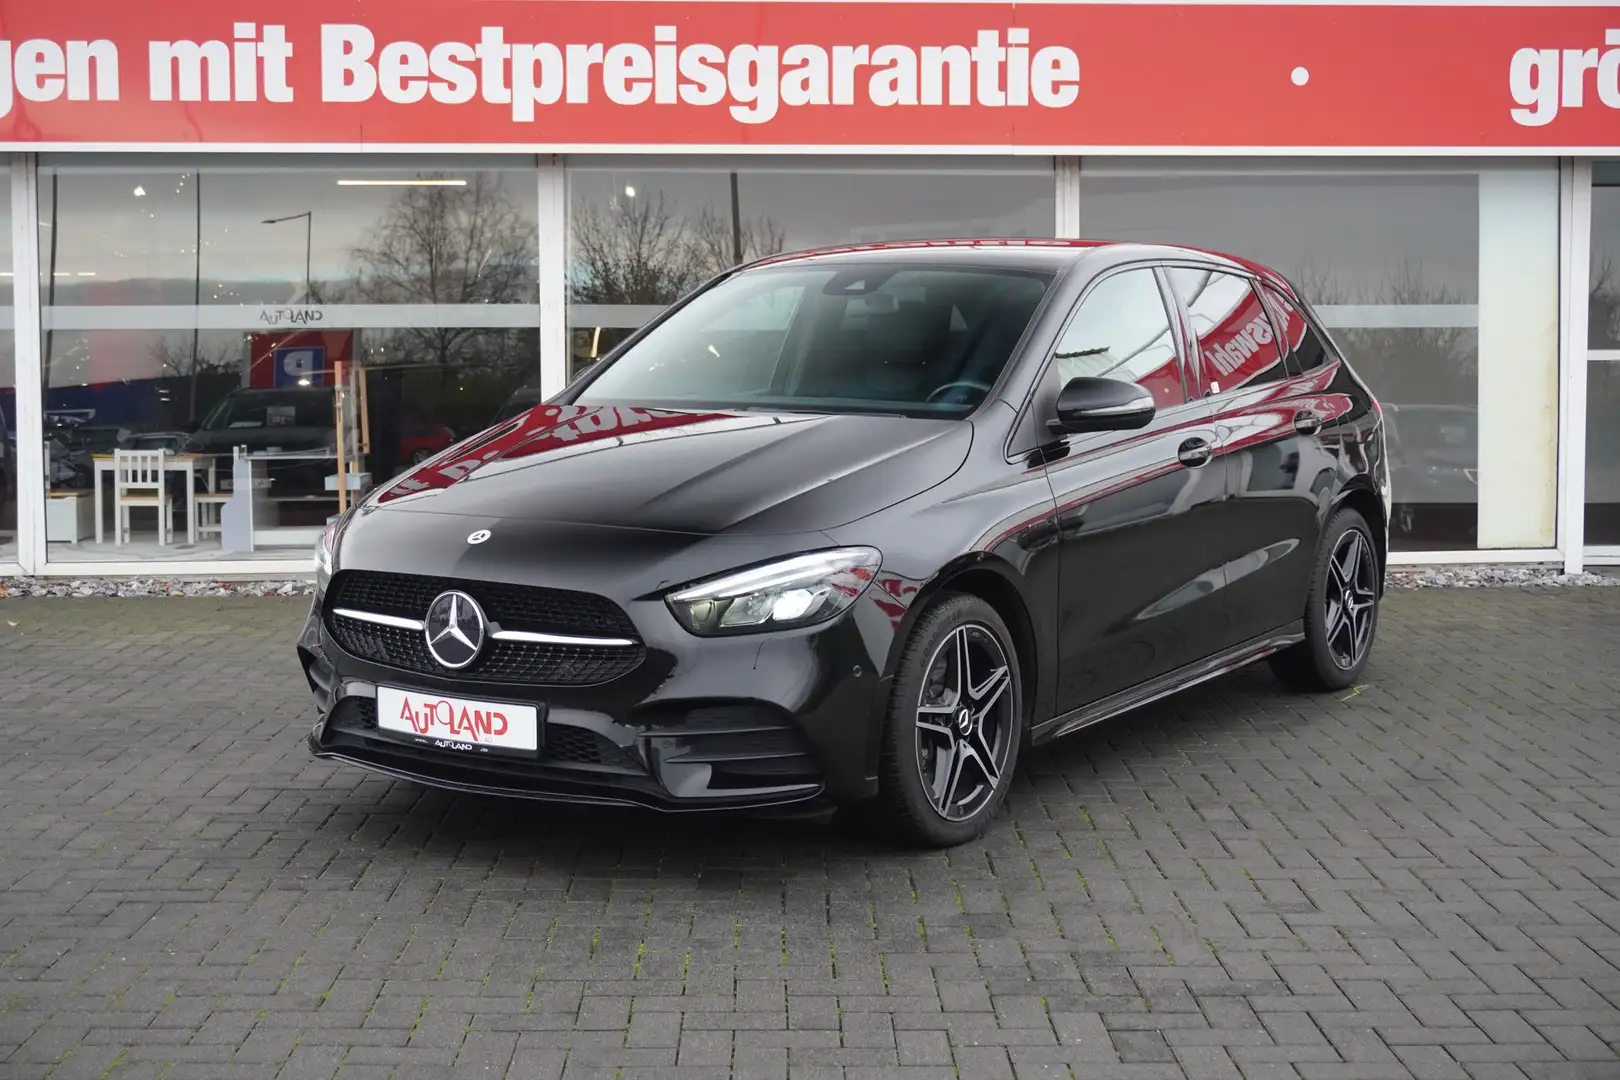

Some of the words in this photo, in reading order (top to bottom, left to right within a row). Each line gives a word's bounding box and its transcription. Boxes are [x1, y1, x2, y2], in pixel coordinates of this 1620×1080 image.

[0, 39, 119, 118] en
[149, 23, 293, 102] mit
[321, 24, 1080, 123] Bestpreisgarantie
